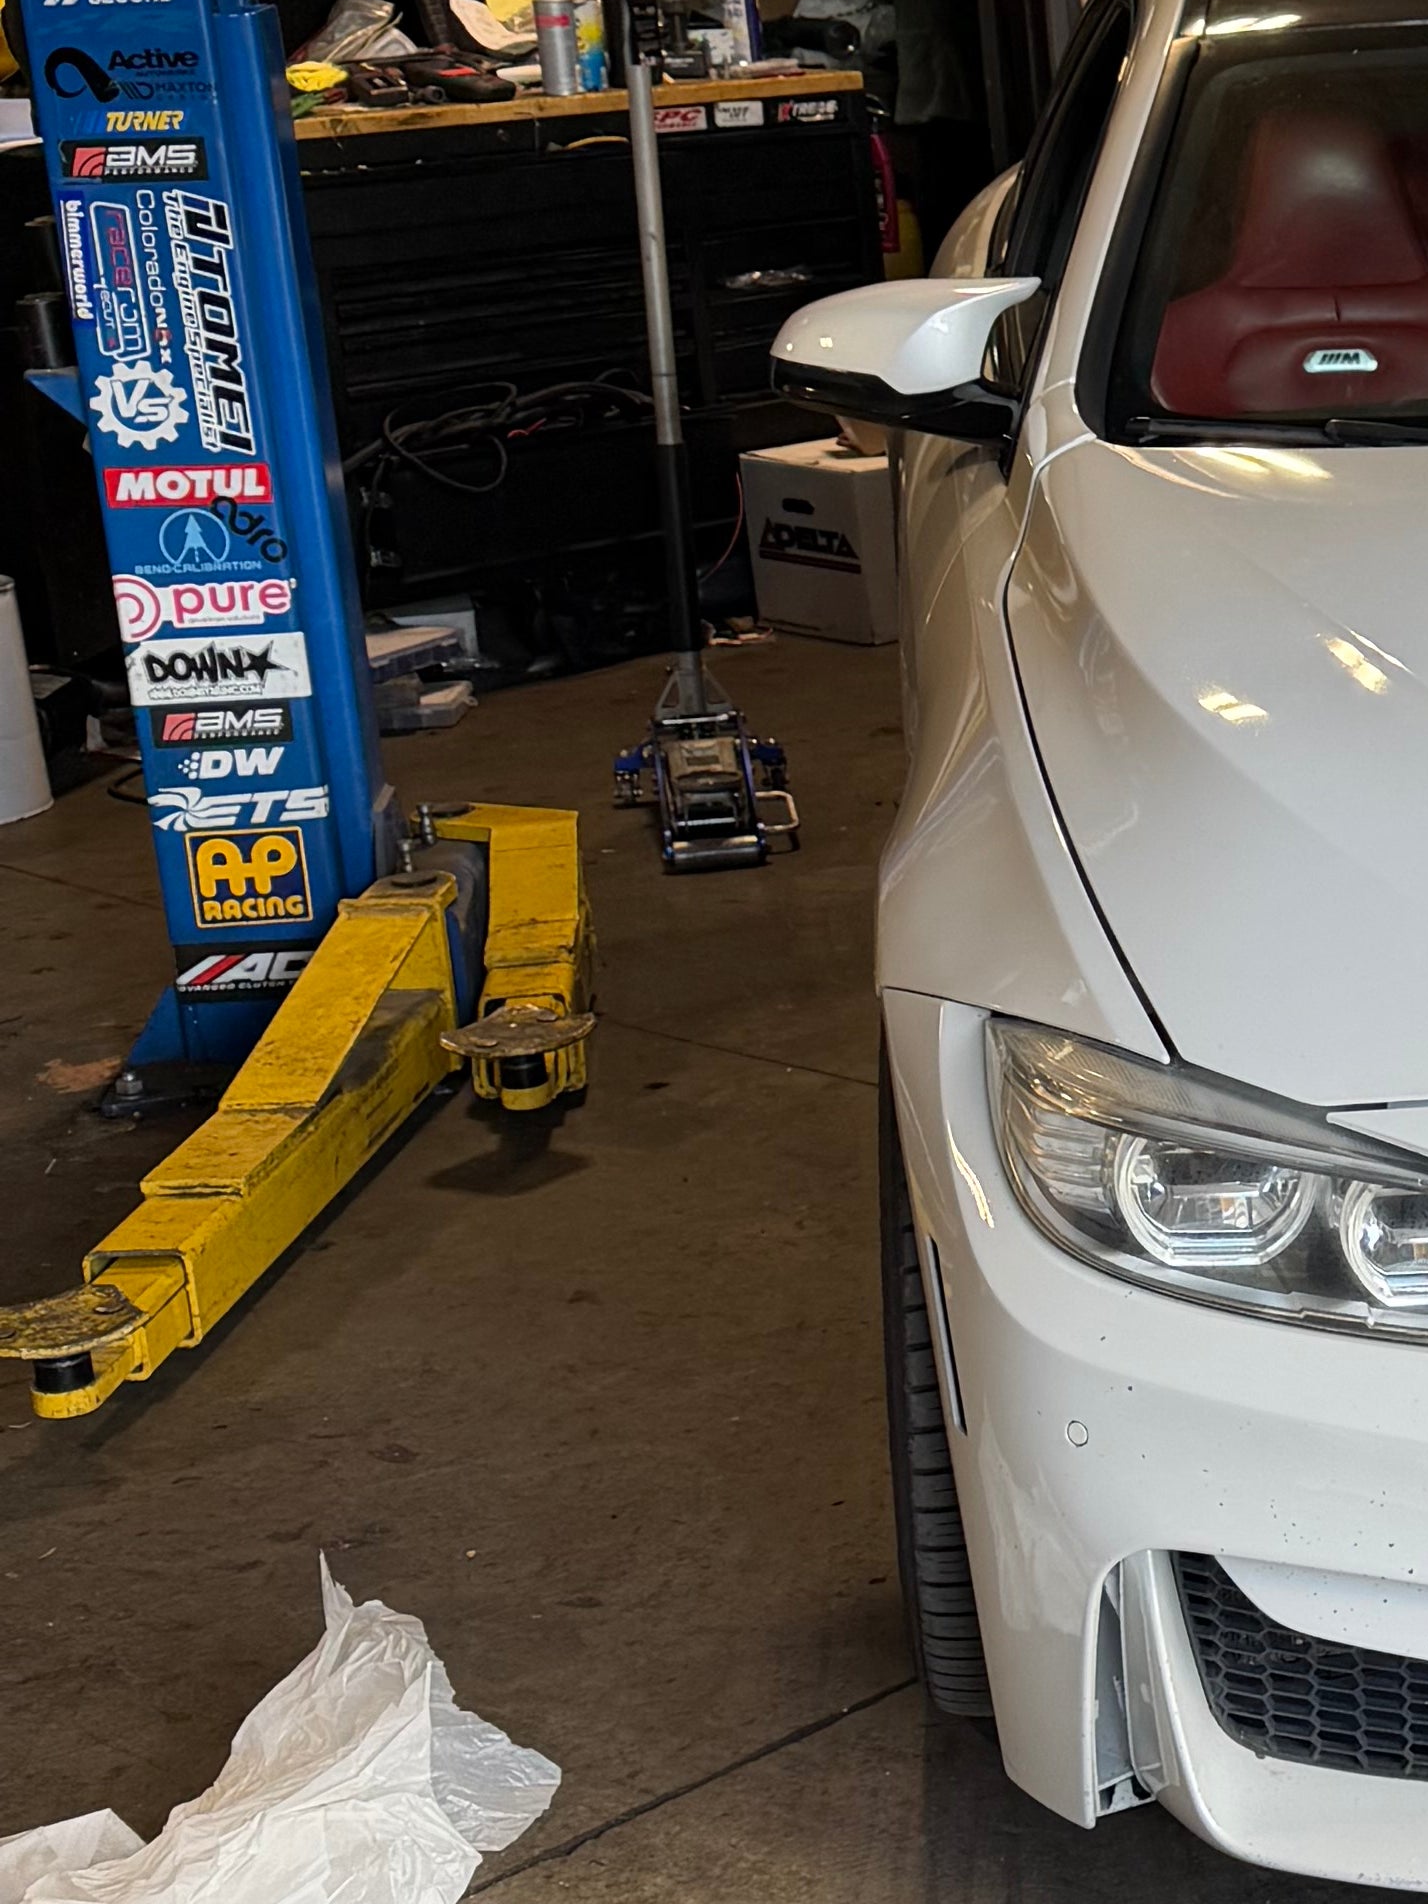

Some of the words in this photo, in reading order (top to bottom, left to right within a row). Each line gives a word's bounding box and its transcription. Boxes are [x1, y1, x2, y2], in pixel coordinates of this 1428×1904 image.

[107, 48, 200, 71] Active
[105, 110, 185, 133] TURNER
[65, 199, 94, 320] bimmerworld
[190, 245, 256, 456] TOMEI
[115, 467, 266, 502] MOTUL
[172, 581, 290, 624] pure
[198, 747, 285, 780] DW
[196, 835, 298, 898] AP
[202, 895, 305, 922] RACING
